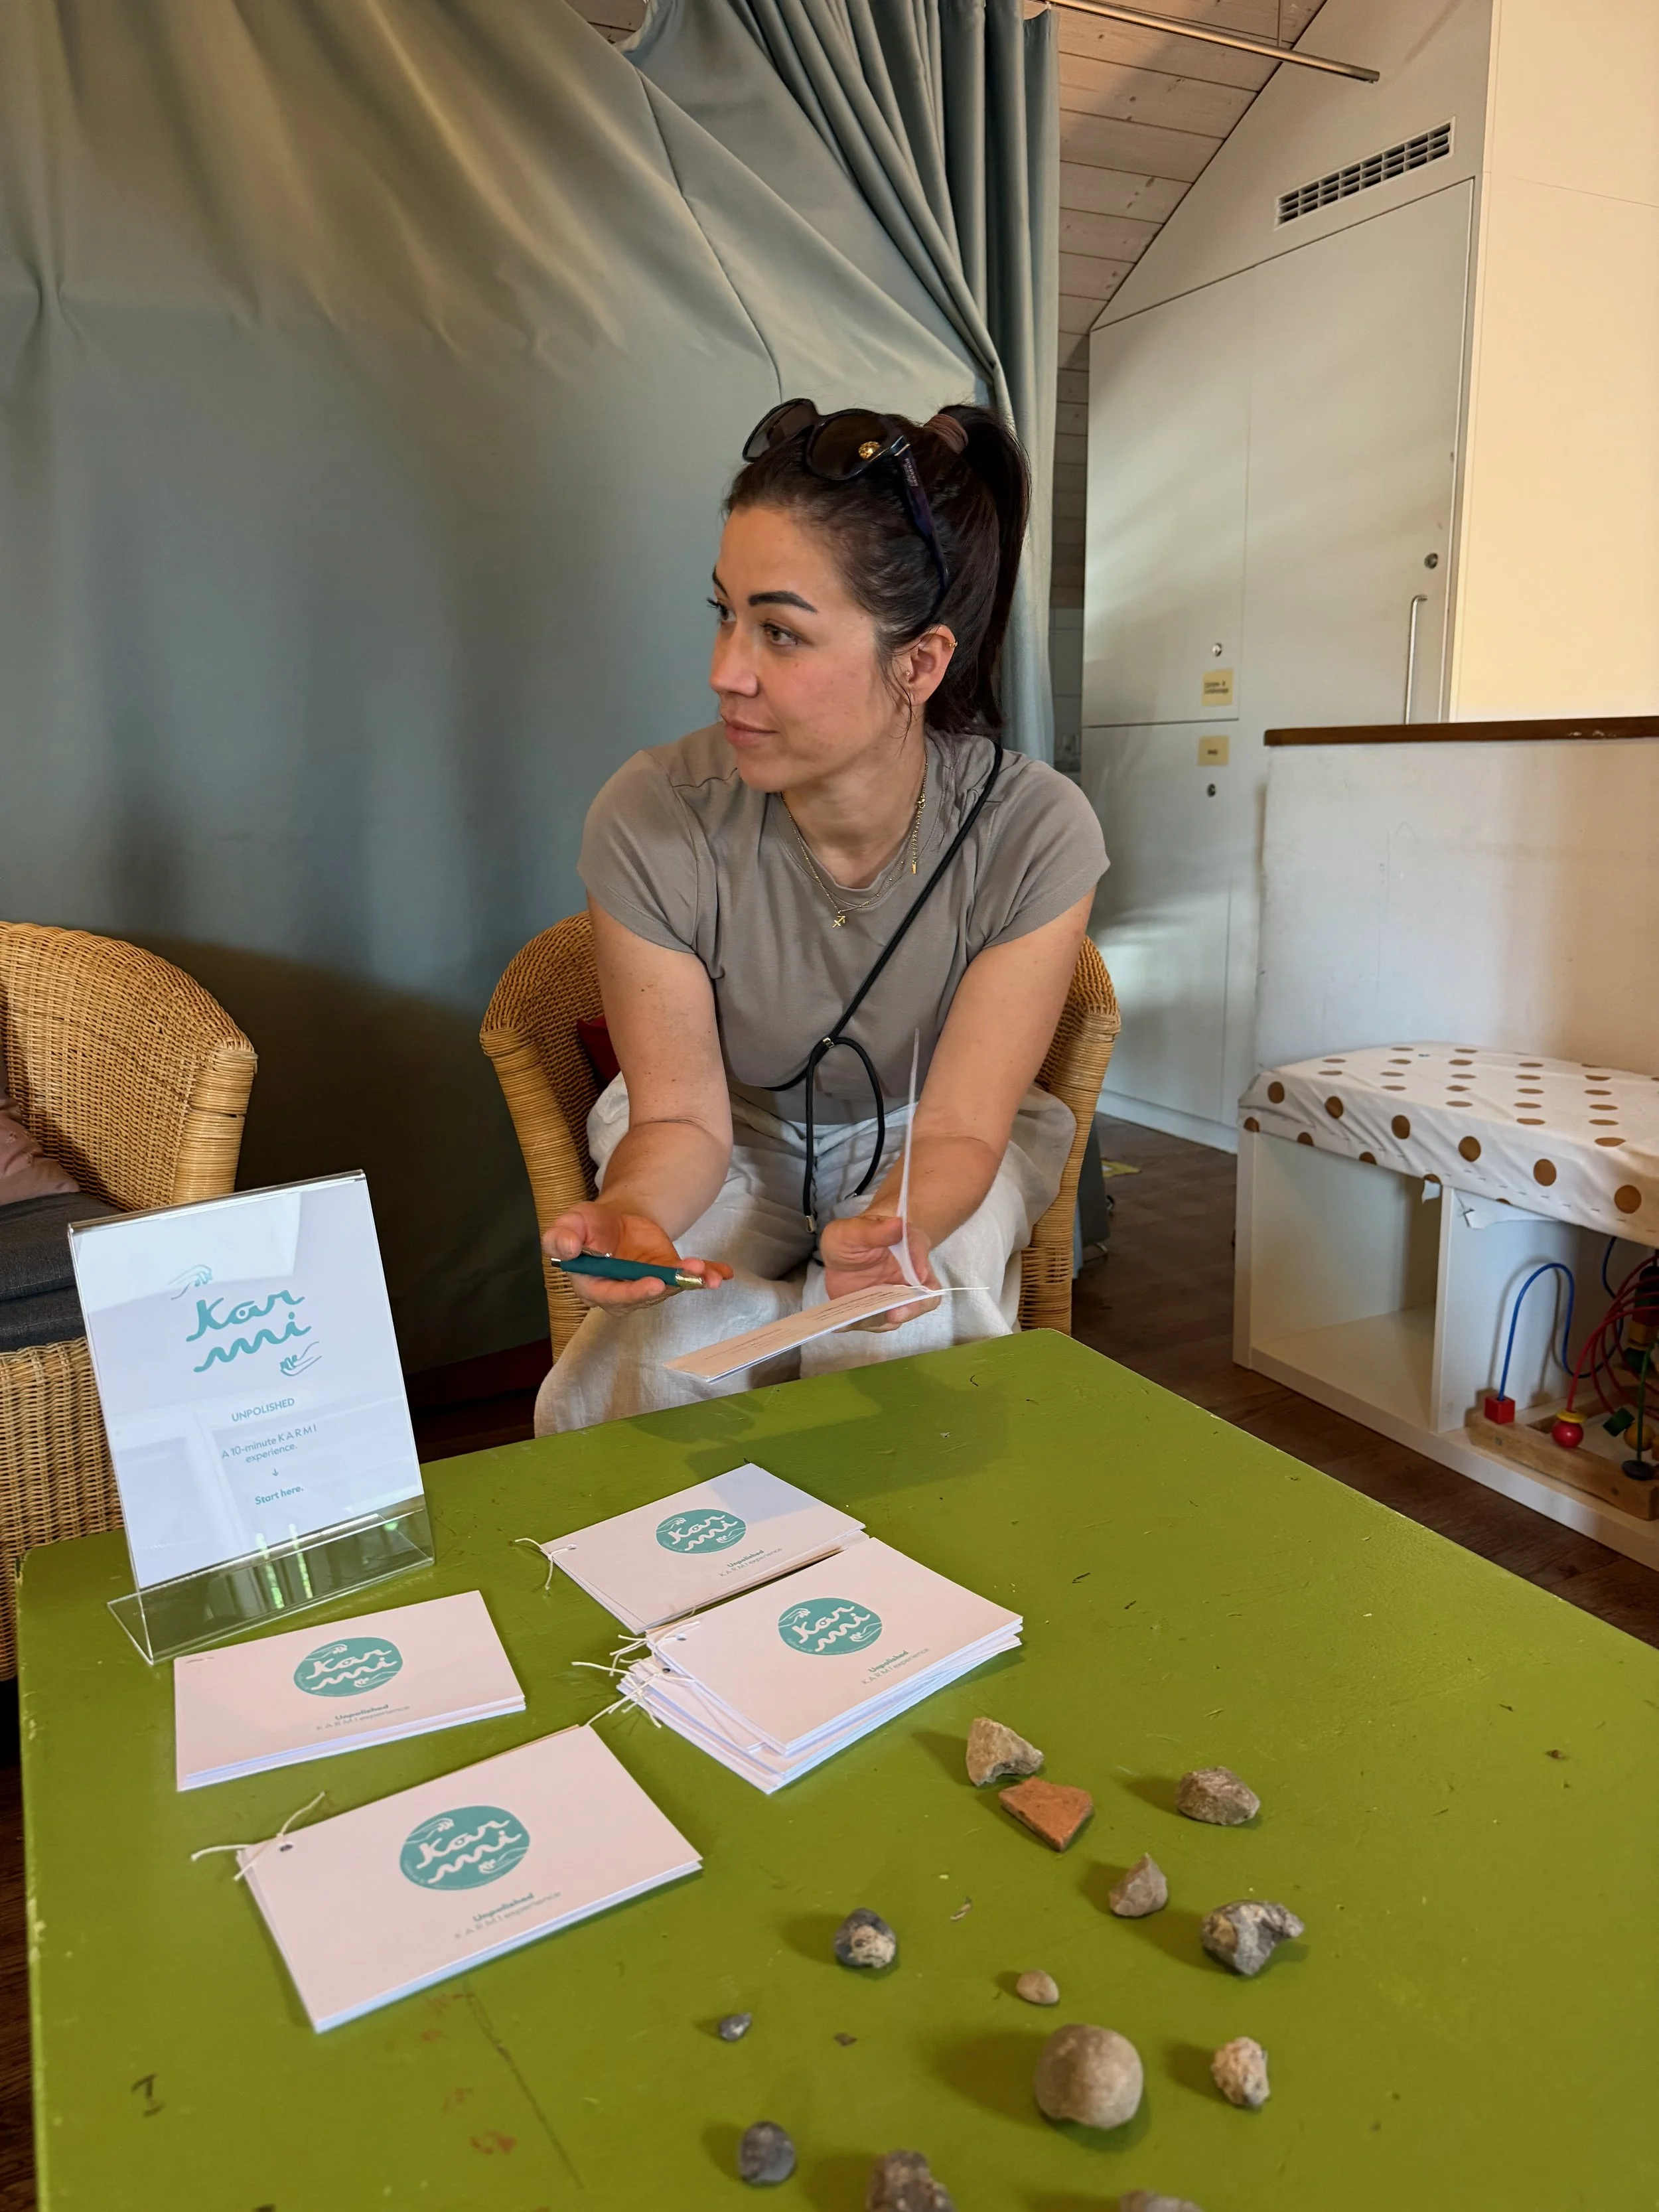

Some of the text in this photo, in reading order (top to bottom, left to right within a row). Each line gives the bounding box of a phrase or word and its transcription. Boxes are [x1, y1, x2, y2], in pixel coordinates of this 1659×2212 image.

[232, 1398, 295, 1422] UNPOLISHED
[222, 1449, 230, 1459] A
[231, 1438, 277, 1456] 10-minute
[246, 1443, 298, 1463] experience.
[255, 1485, 304, 1505] Start here.
[727, 1549, 764, 1568] Unpolished
[749, 1548, 782, 1565] experience
[867, 1650, 909, 1672] Unpolished
[893, 1647, 930, 1669] experience
[334, 1704, 389, 1720] Unpolished
[472, 1892, 534, 1922] Unpolished
